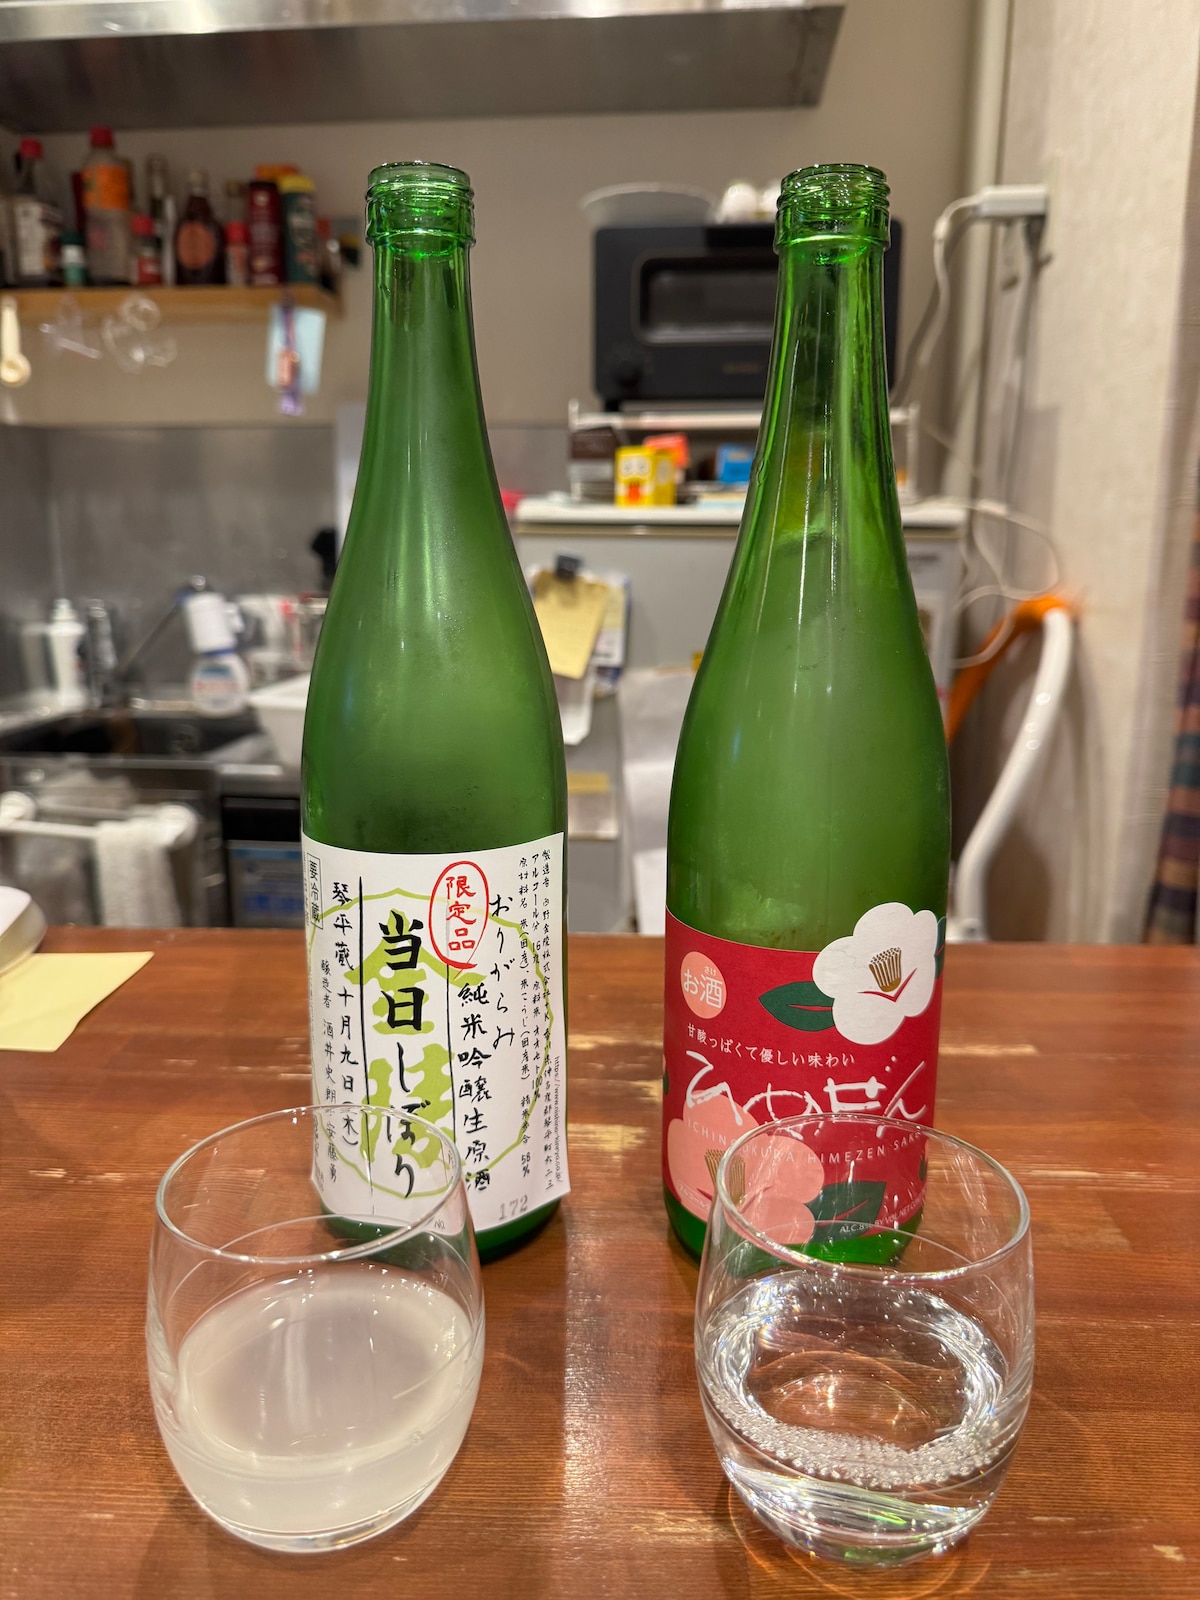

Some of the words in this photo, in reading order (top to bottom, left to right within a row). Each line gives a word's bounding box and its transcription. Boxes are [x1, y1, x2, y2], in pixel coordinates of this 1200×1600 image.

[445, 875, 477, 951] 限定品
[488, 893, 516, 1050] おりがらみ
[683, 969, 724, 1010] お酒
[704, 966, 717, 976] さけ
[378, 909, 432, 1199] 当日しぼり
[687, 1022, 855, 1068] 甘酸っぱくて優しい味わい
[457, 982, 492, 1192] 純米吟醸生原酒
[685, 1050, 927, 1140] ひめぜん
[807, 1144, 886, 1164] HIMEZEN
[498, 1194, 529, 1221] 172
